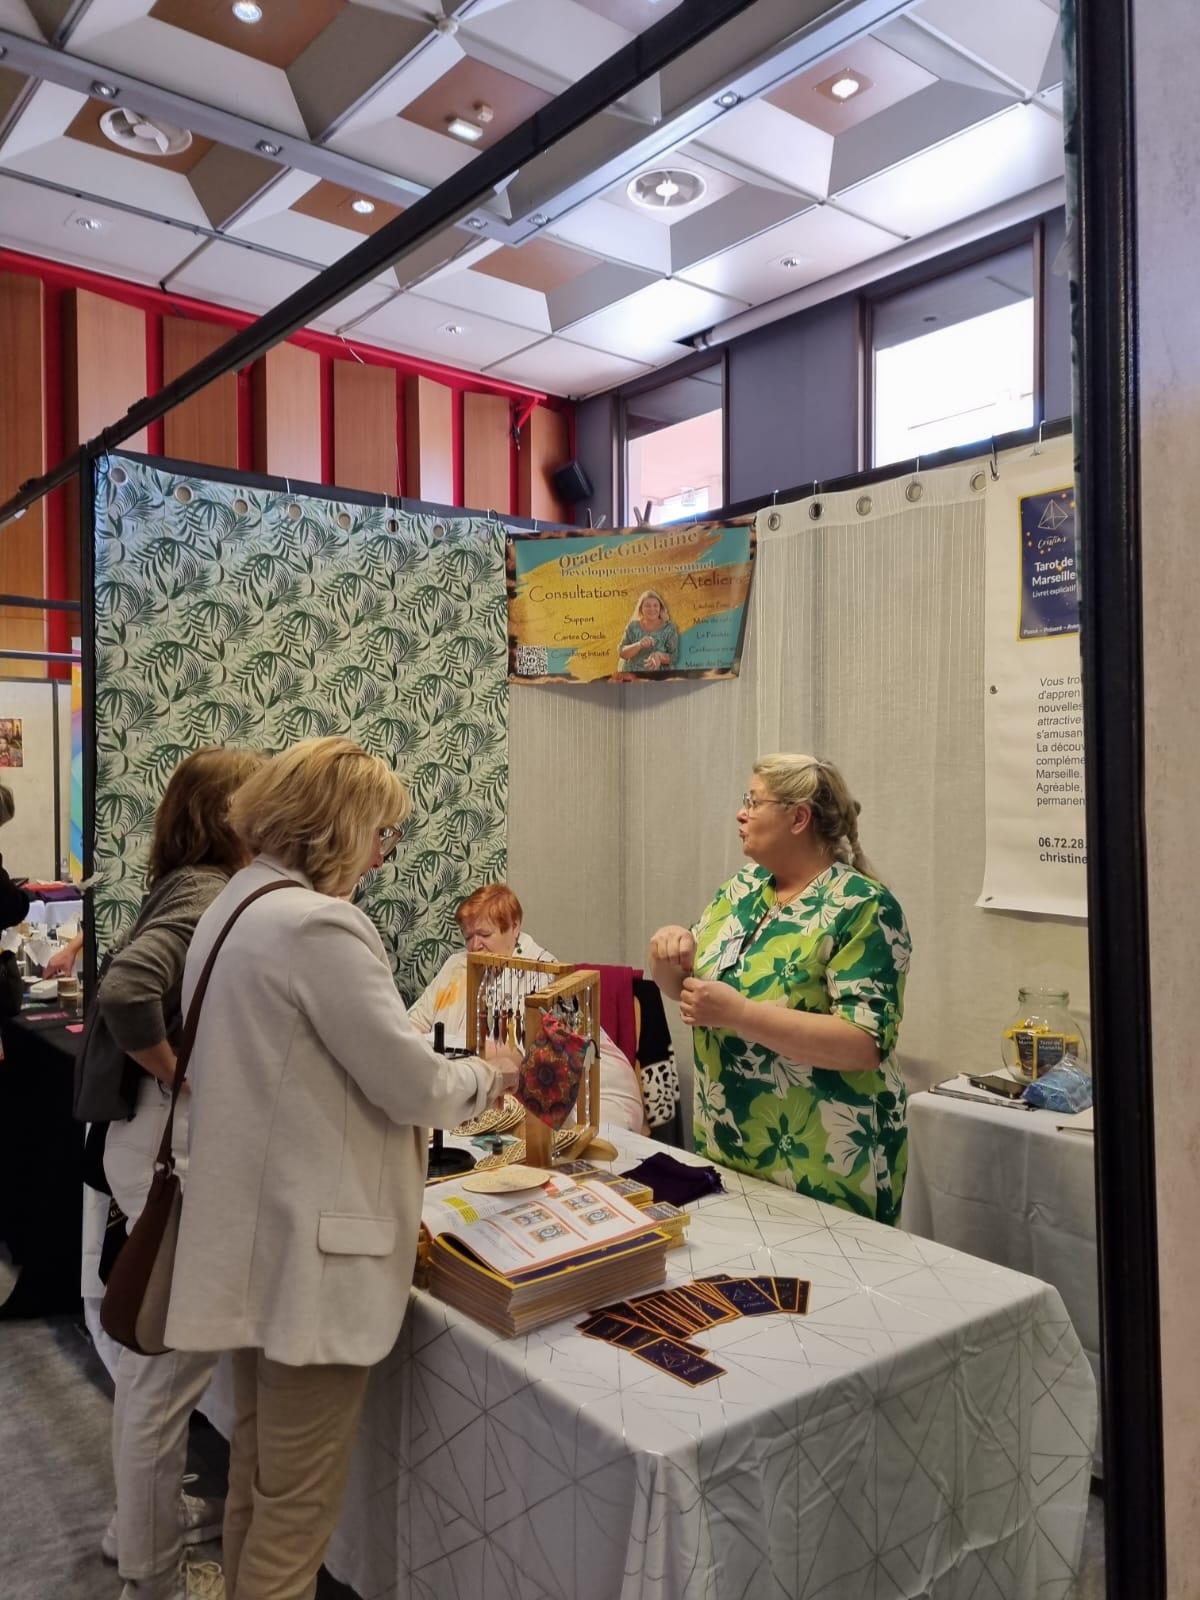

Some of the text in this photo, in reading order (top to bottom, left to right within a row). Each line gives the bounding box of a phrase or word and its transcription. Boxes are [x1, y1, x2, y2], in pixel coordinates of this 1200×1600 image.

[1034, 556, 1073, 572] Tarot de
[1032, 570, 1076, 587] Marseille
[529, 584, 628, 602] Consultations
[1032, 589, 1049, 598] Livret
[564, 614, 594, 625] Support
[581, 631, 606, 641] Oracle
[1040, 677, 1064, 686] Vous
[1038, 689, 1080, 701] d'appren
[1038, 701, 1084, 712] nouvelles
[1037, 716, 1082, 726] attractive
[1036, 743, 1048, 752] La
[1036, 769, 1083, 779] Marseille.
[1036, 782, 1083, 794] Agréable,
[1040, 852, 1087, 864] christine
